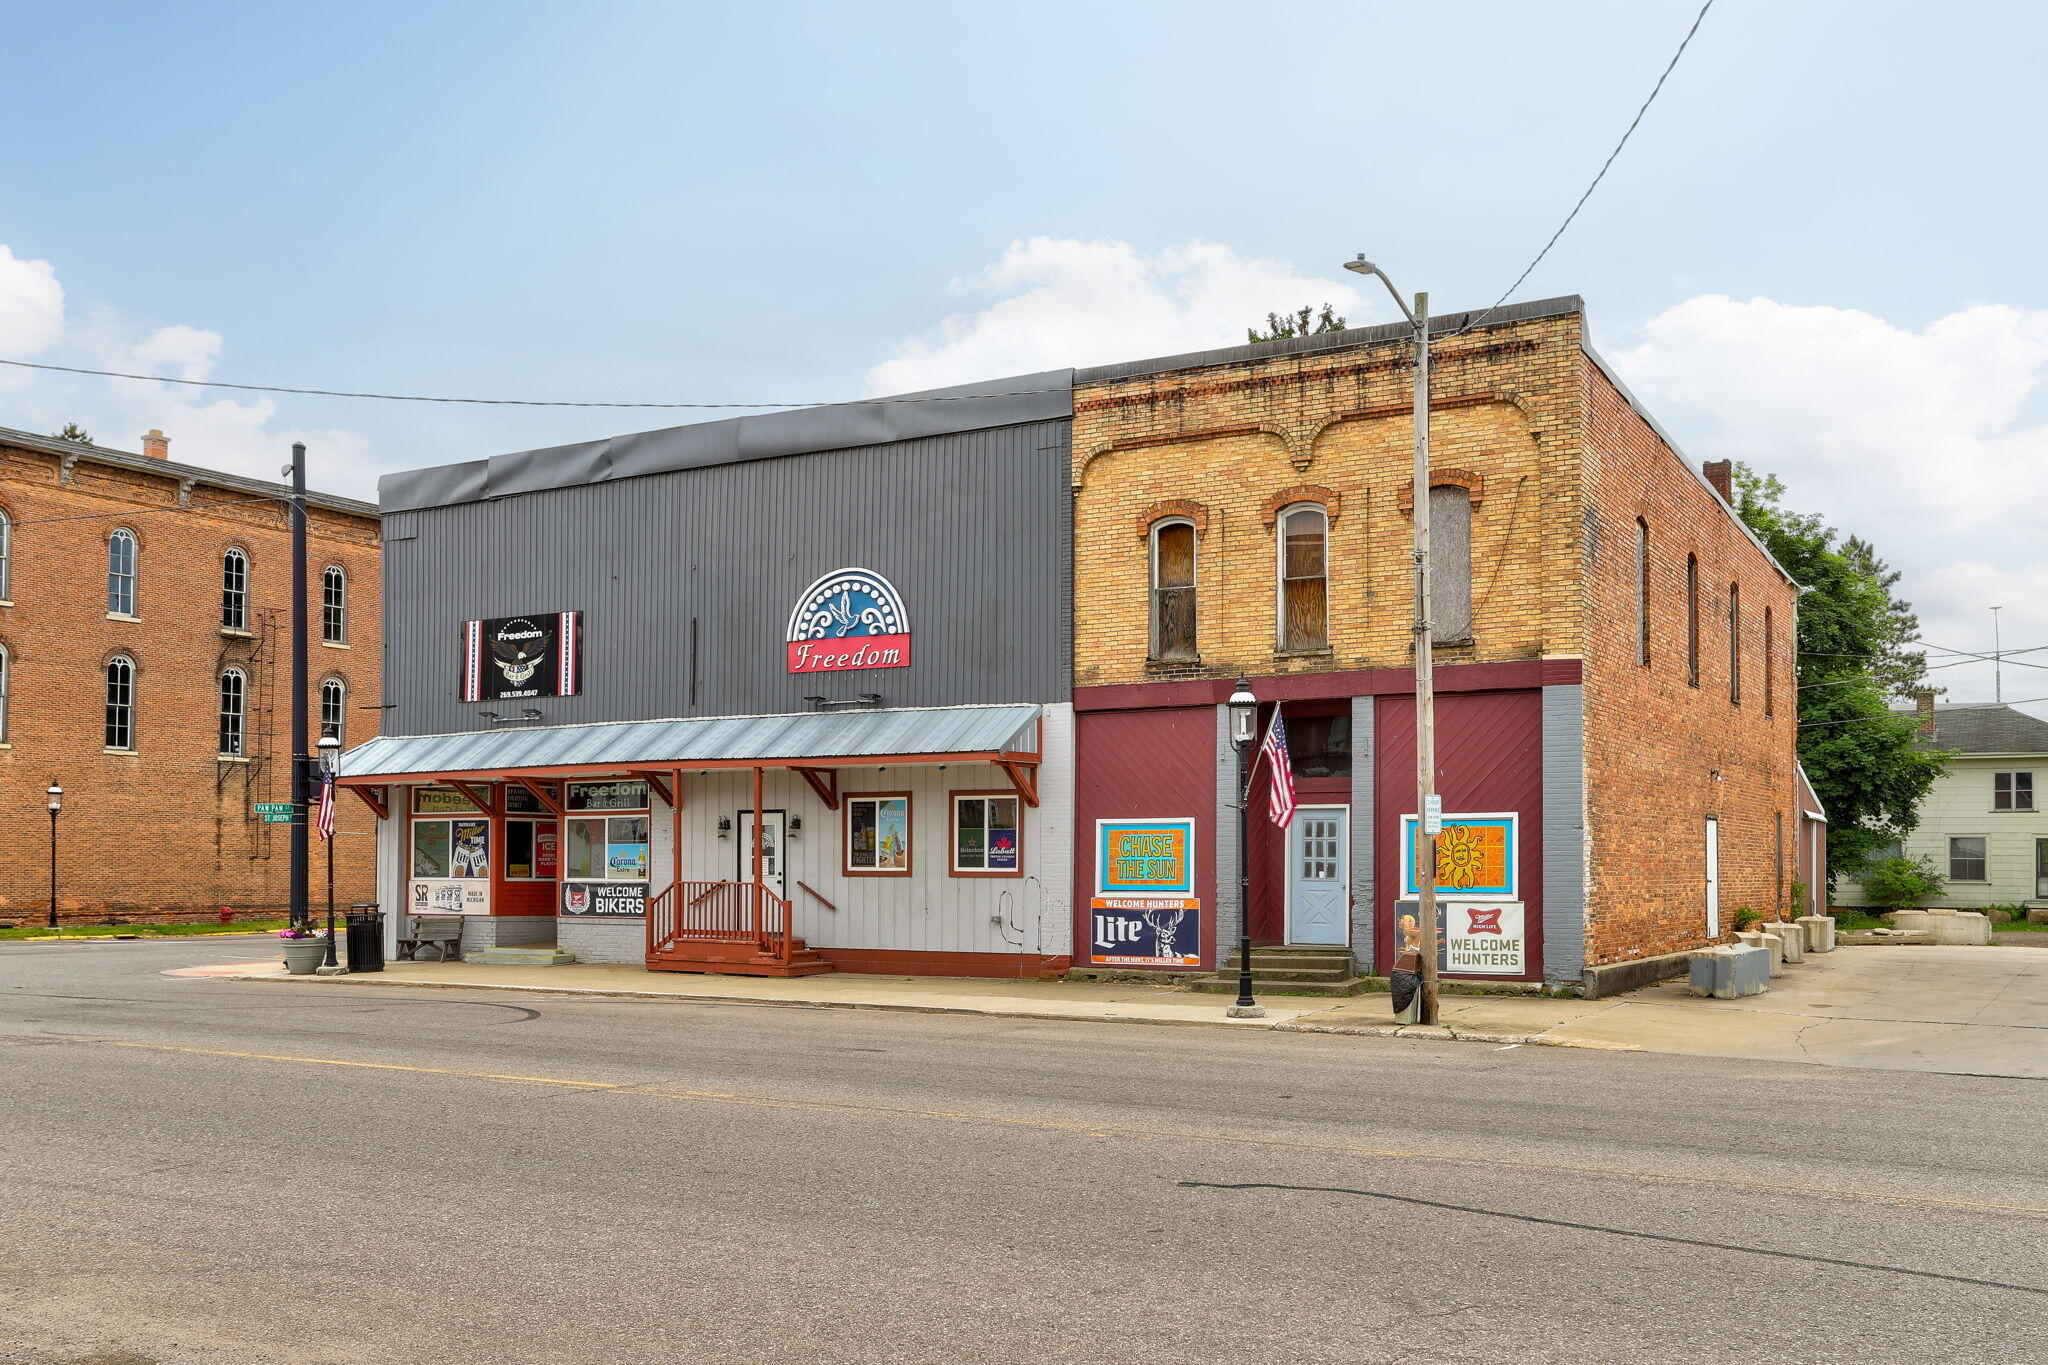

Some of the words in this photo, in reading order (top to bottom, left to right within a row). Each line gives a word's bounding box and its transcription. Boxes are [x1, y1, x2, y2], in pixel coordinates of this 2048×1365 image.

[498, 630, 542, 641] Freedom
[794, 643, 901, 669] Freedom
[570, 782, 647, 798] Freedom
[257, 804, 270, 812] PAW
[271, 804, 284, 812] PAW
[587, 798, 600, 808] Bar
[602, 800, 608, 808] &
[609, 798, 630, 808] Grill
[264, 814, 271, 822] ST
[272, 814, 289, 822] JOSEPH
[880, 808, 905, 818] Corona
[455, 825, 485, 841] Miller
[470, 836, 485, 844] TIME
[542, 842, 556, 850] ICE
[989, 846, 1015, 854] Labatt
[1119, 834, 1173, 858] CHASE
[610, 856, 636, 867] Corona
[616, 865, 630, 873] Extra
[1116, 859, 1144, 879] THE
[1146, 859, 1176, 880] SUN
[415, 884, 429, 902] SR
[597, 886, 643, 897] WELCOME
[595, 897, 644, 914] BIKERS
[1105, 900, 1145, 908] WELCOME
[1146, 900, 1185, 909] HUNTERS
[1474, 913, 1494, 924] Miller
[1094, 914, 1143, 949] Lite
[1450, 938, 1520, 952] WELCOME
[1452, 952, 1519, 966] HUNTERS
